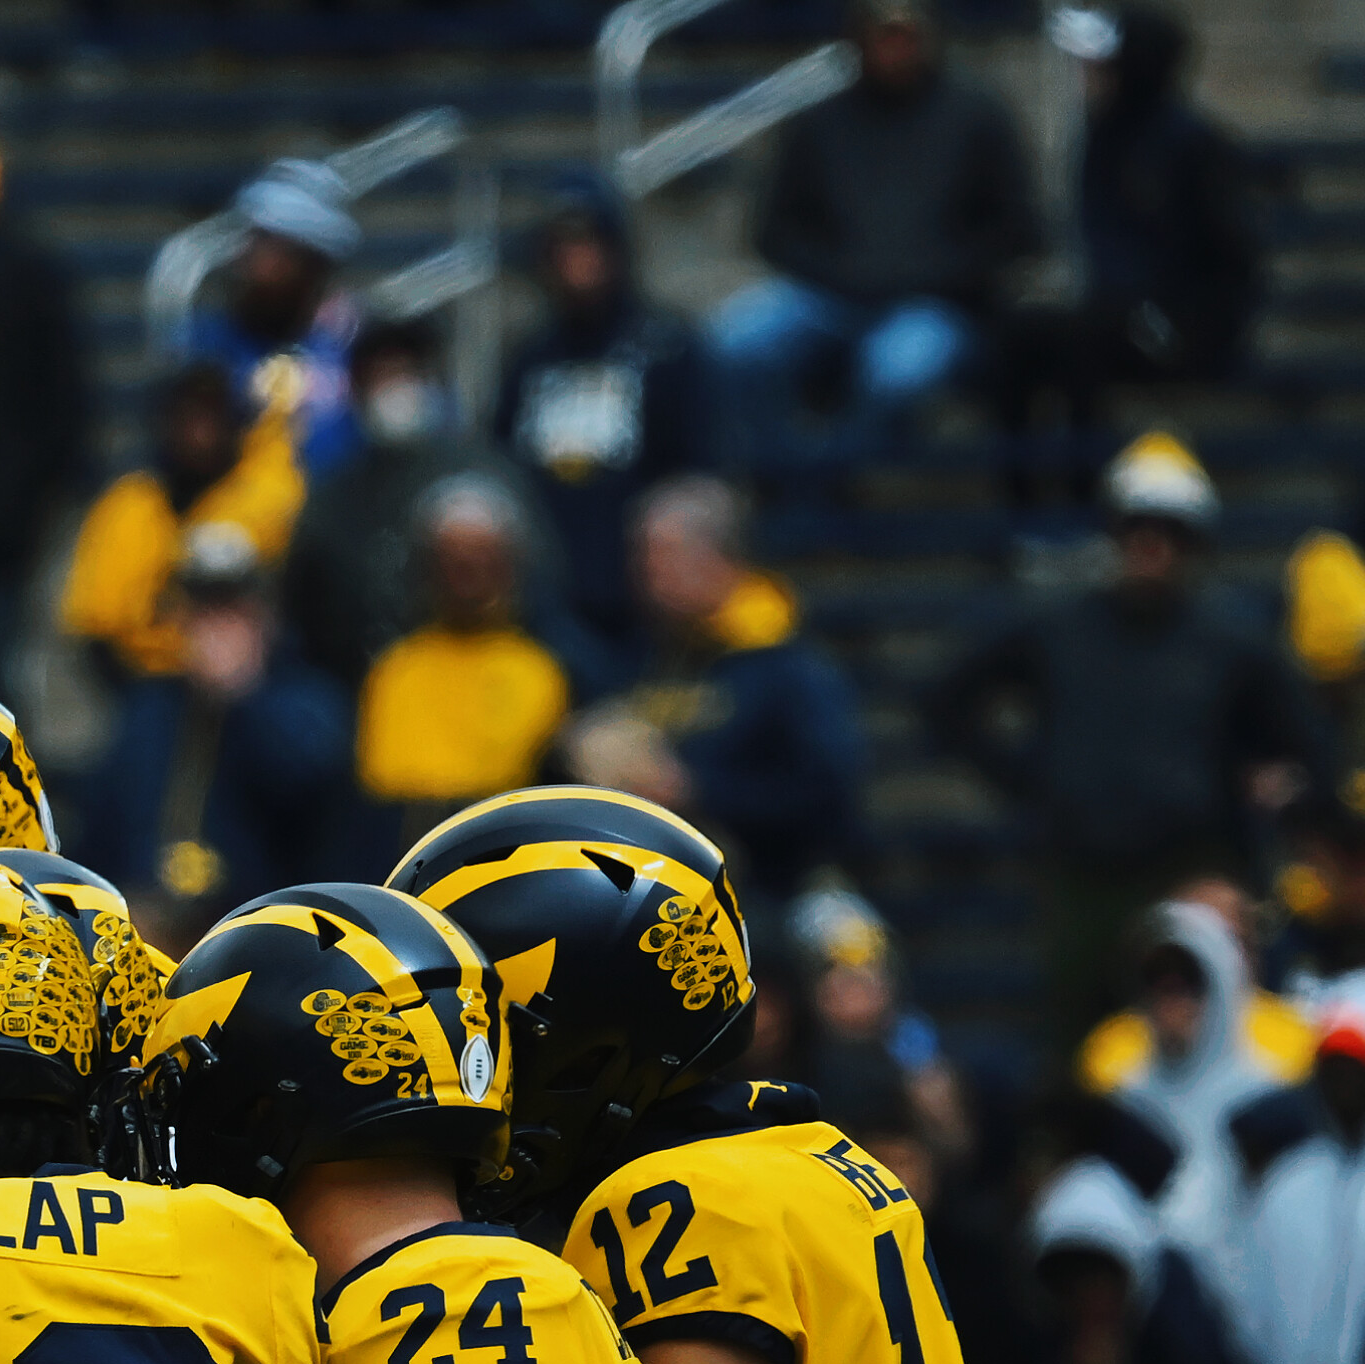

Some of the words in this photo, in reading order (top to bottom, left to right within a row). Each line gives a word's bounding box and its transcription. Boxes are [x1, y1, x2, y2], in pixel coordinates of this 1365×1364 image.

[721, 981, 736, 1011] 12
[34, 1034, 57, 1049] TED
[340, 1041, 369, 1051] GAME
[397, 1072, 429, 1099] 24
[589, 1180, 719, 1325] 12
